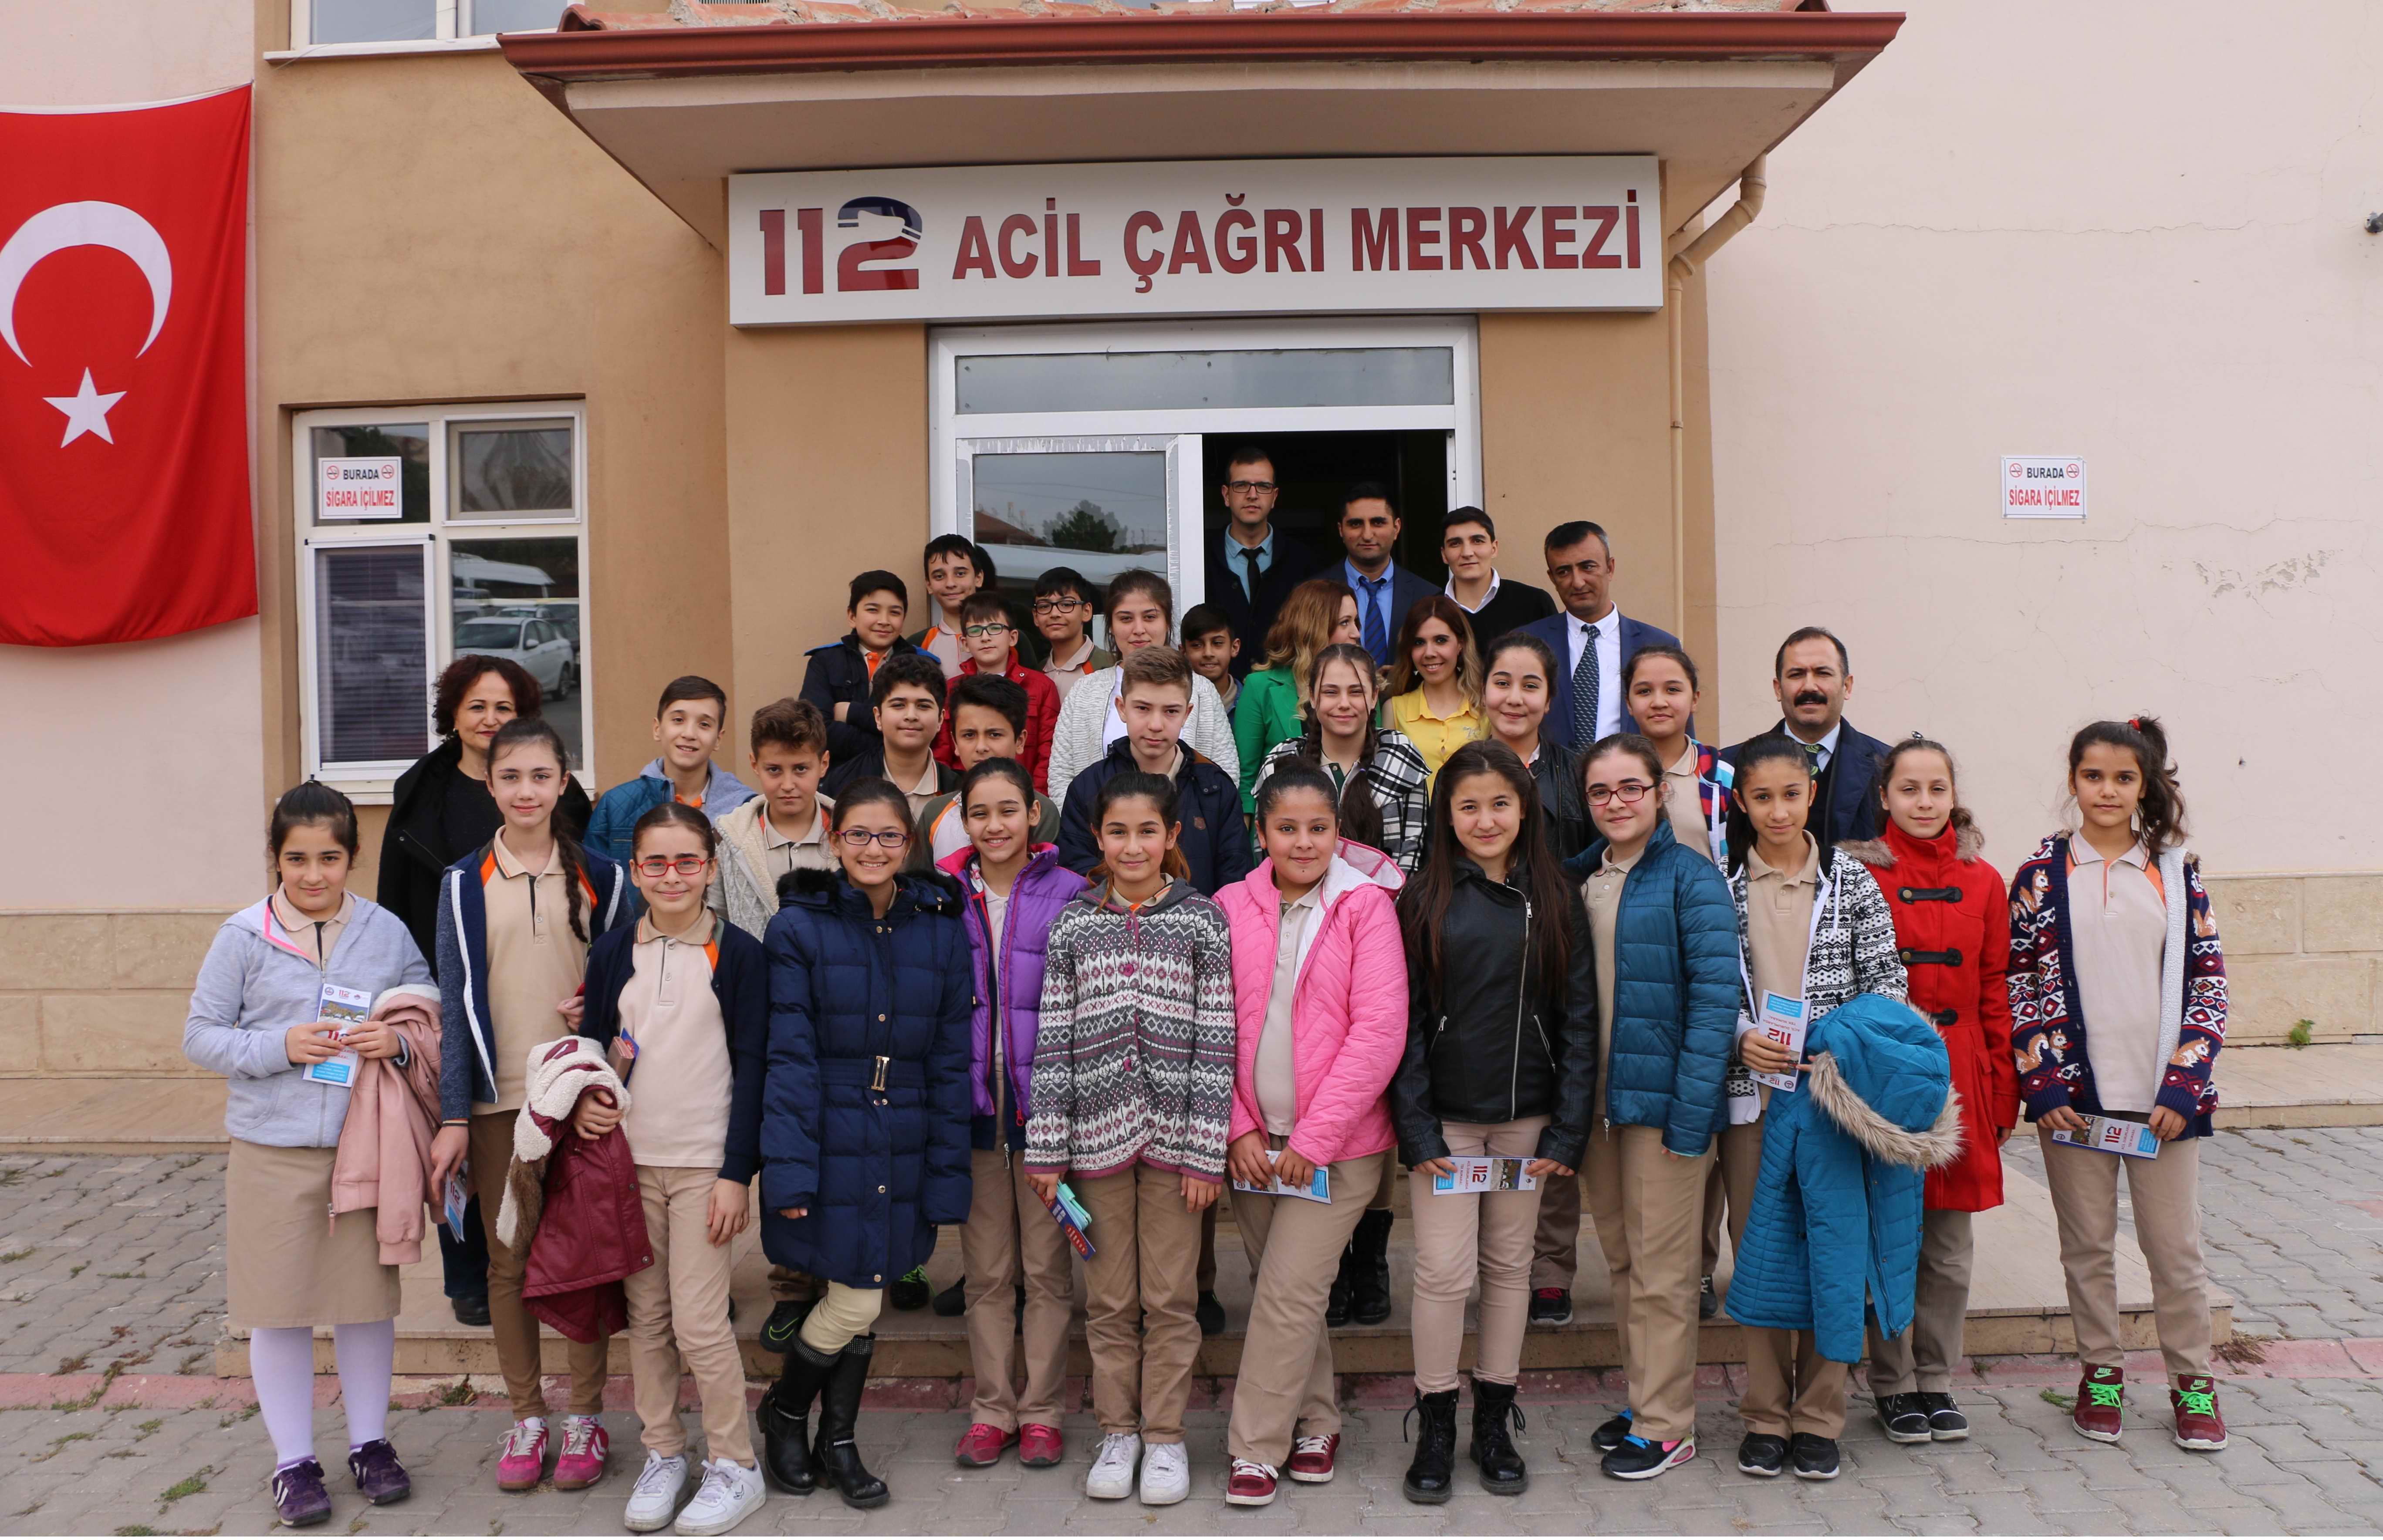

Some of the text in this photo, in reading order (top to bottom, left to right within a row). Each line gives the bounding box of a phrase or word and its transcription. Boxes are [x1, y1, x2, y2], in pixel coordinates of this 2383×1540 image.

[760, 189, 1641, 296] 112 ACİL ÇAĞRI MERKEZİ
[343, 469, 379, 480] BURADA
[2027, 467, 2064, 478] BURADA
[326, 486, 394, 510] SİGARA İÇİLMEZ
[2009, 485, 2080, 510] SİGARA İÇİLMEZ
[1767, 1027, 1791, 1046] 112
[2104, 1126, 2122, 1143] 112
[1473, 1166, 1487, 1183] 112
